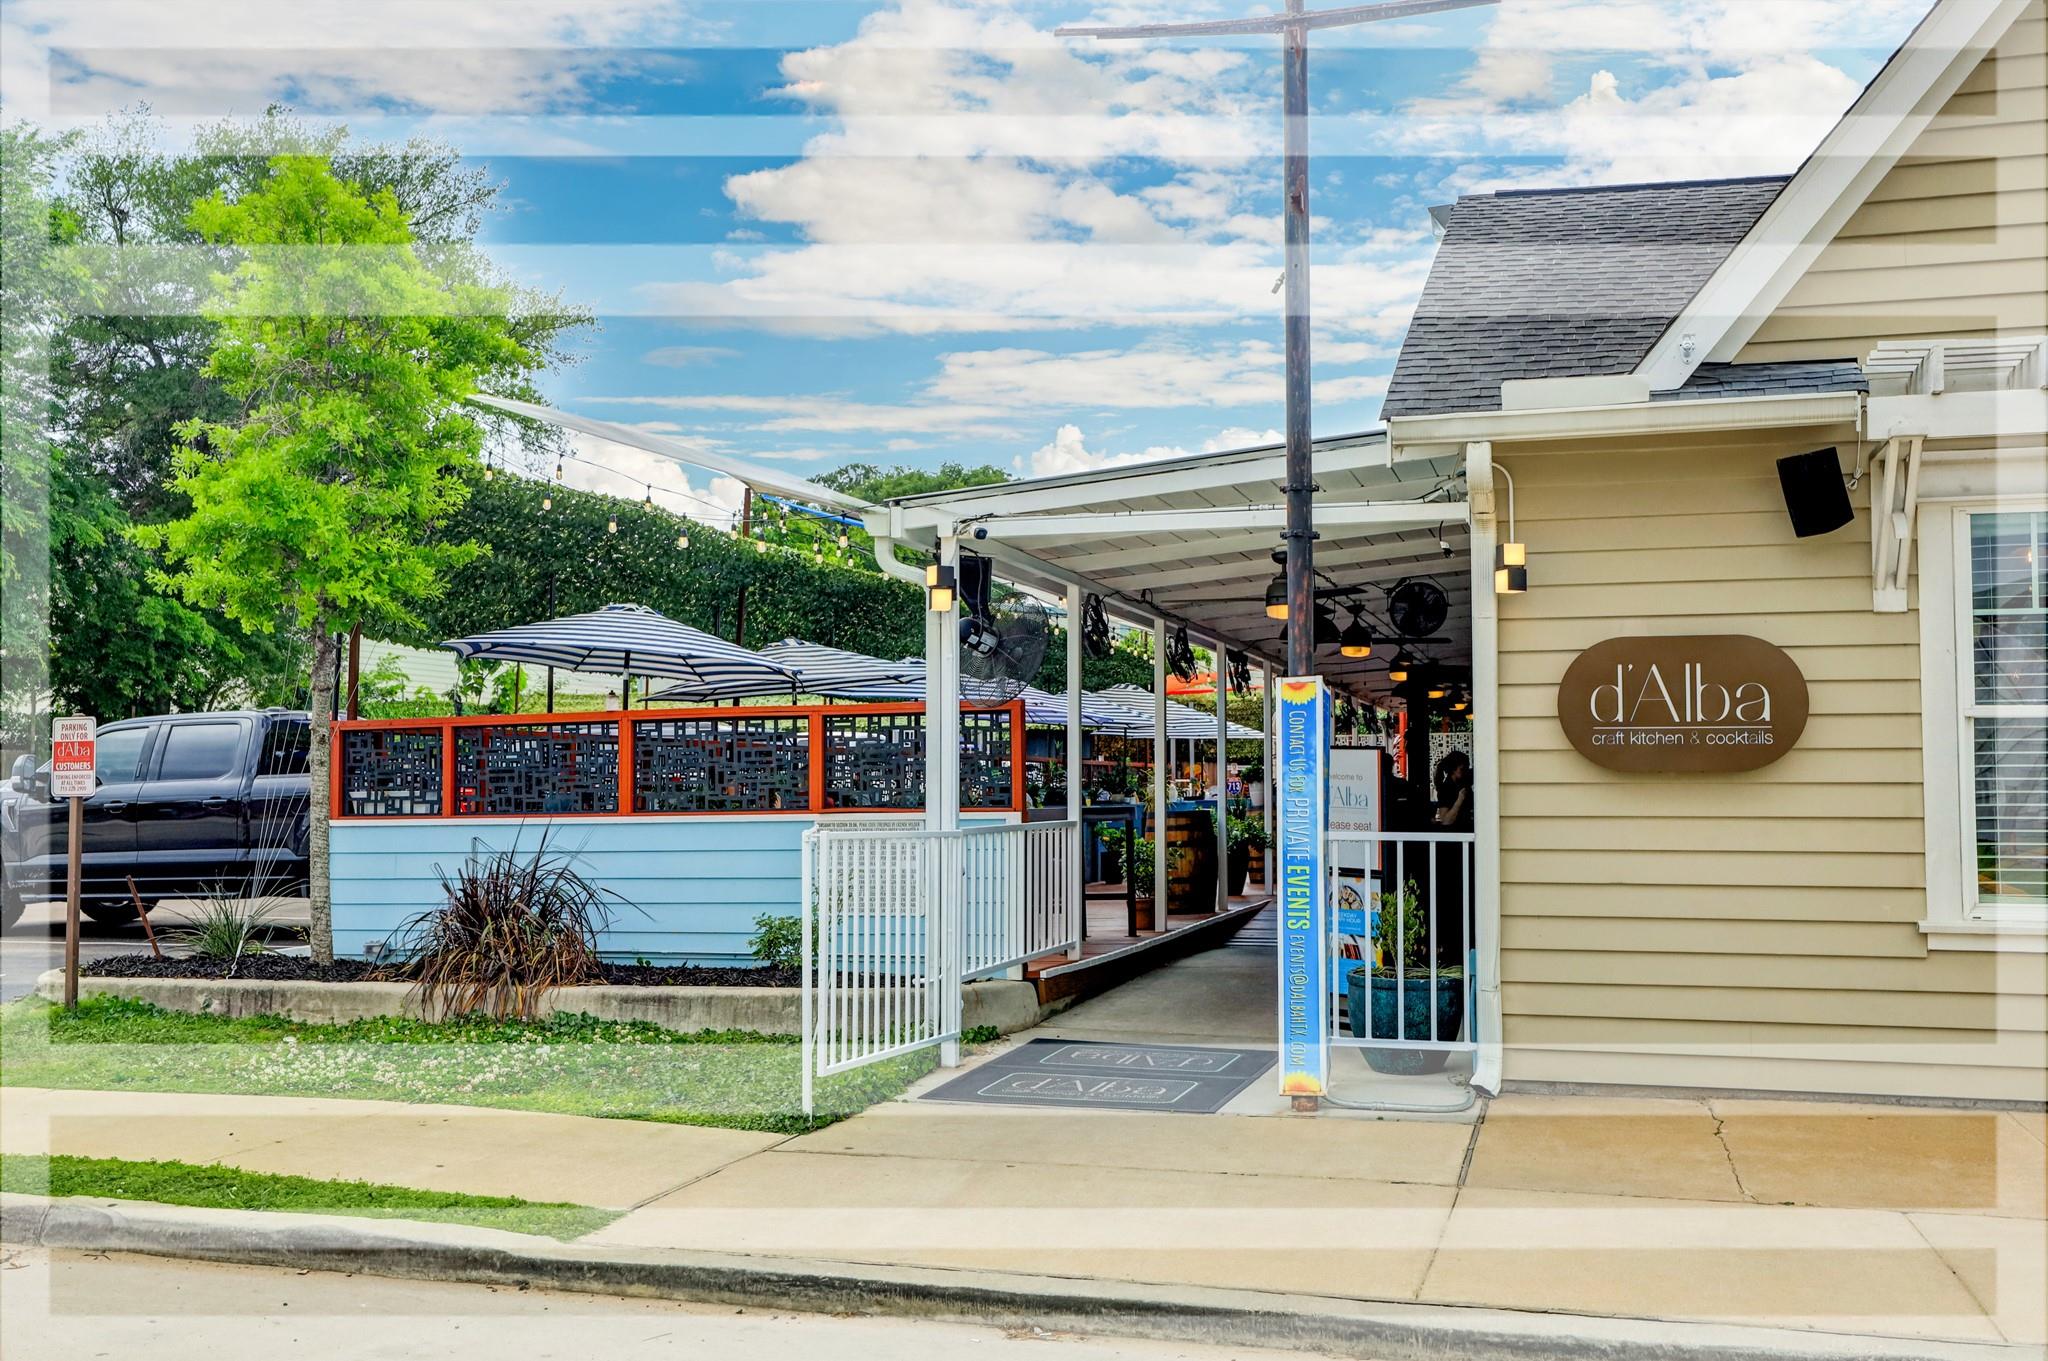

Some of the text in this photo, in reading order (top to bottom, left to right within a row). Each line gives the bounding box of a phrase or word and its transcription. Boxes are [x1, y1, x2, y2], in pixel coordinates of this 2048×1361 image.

[1590, 663, 1771, 722] d'Alba
[61, 723, 88, 731] PARKING
[1288, 710, 1307, 755] CONTACT
[60, 732, 88, 741] ONLY FOR
[1592, 731, 1774, 745] craft kitchen & cocktails
[57, 742, 90, 757] d'Alba
[55, 761, 91, 771] CUSTOMERS
[1228, 782, 1240, 791] 713
[1288, 775, 1305, 793] FOR
[1286, 798, 1310, 862] PRIVATE
[1353, 821, 1372, 832] seat
[1286, 864, 1311, 930] EVENTS
